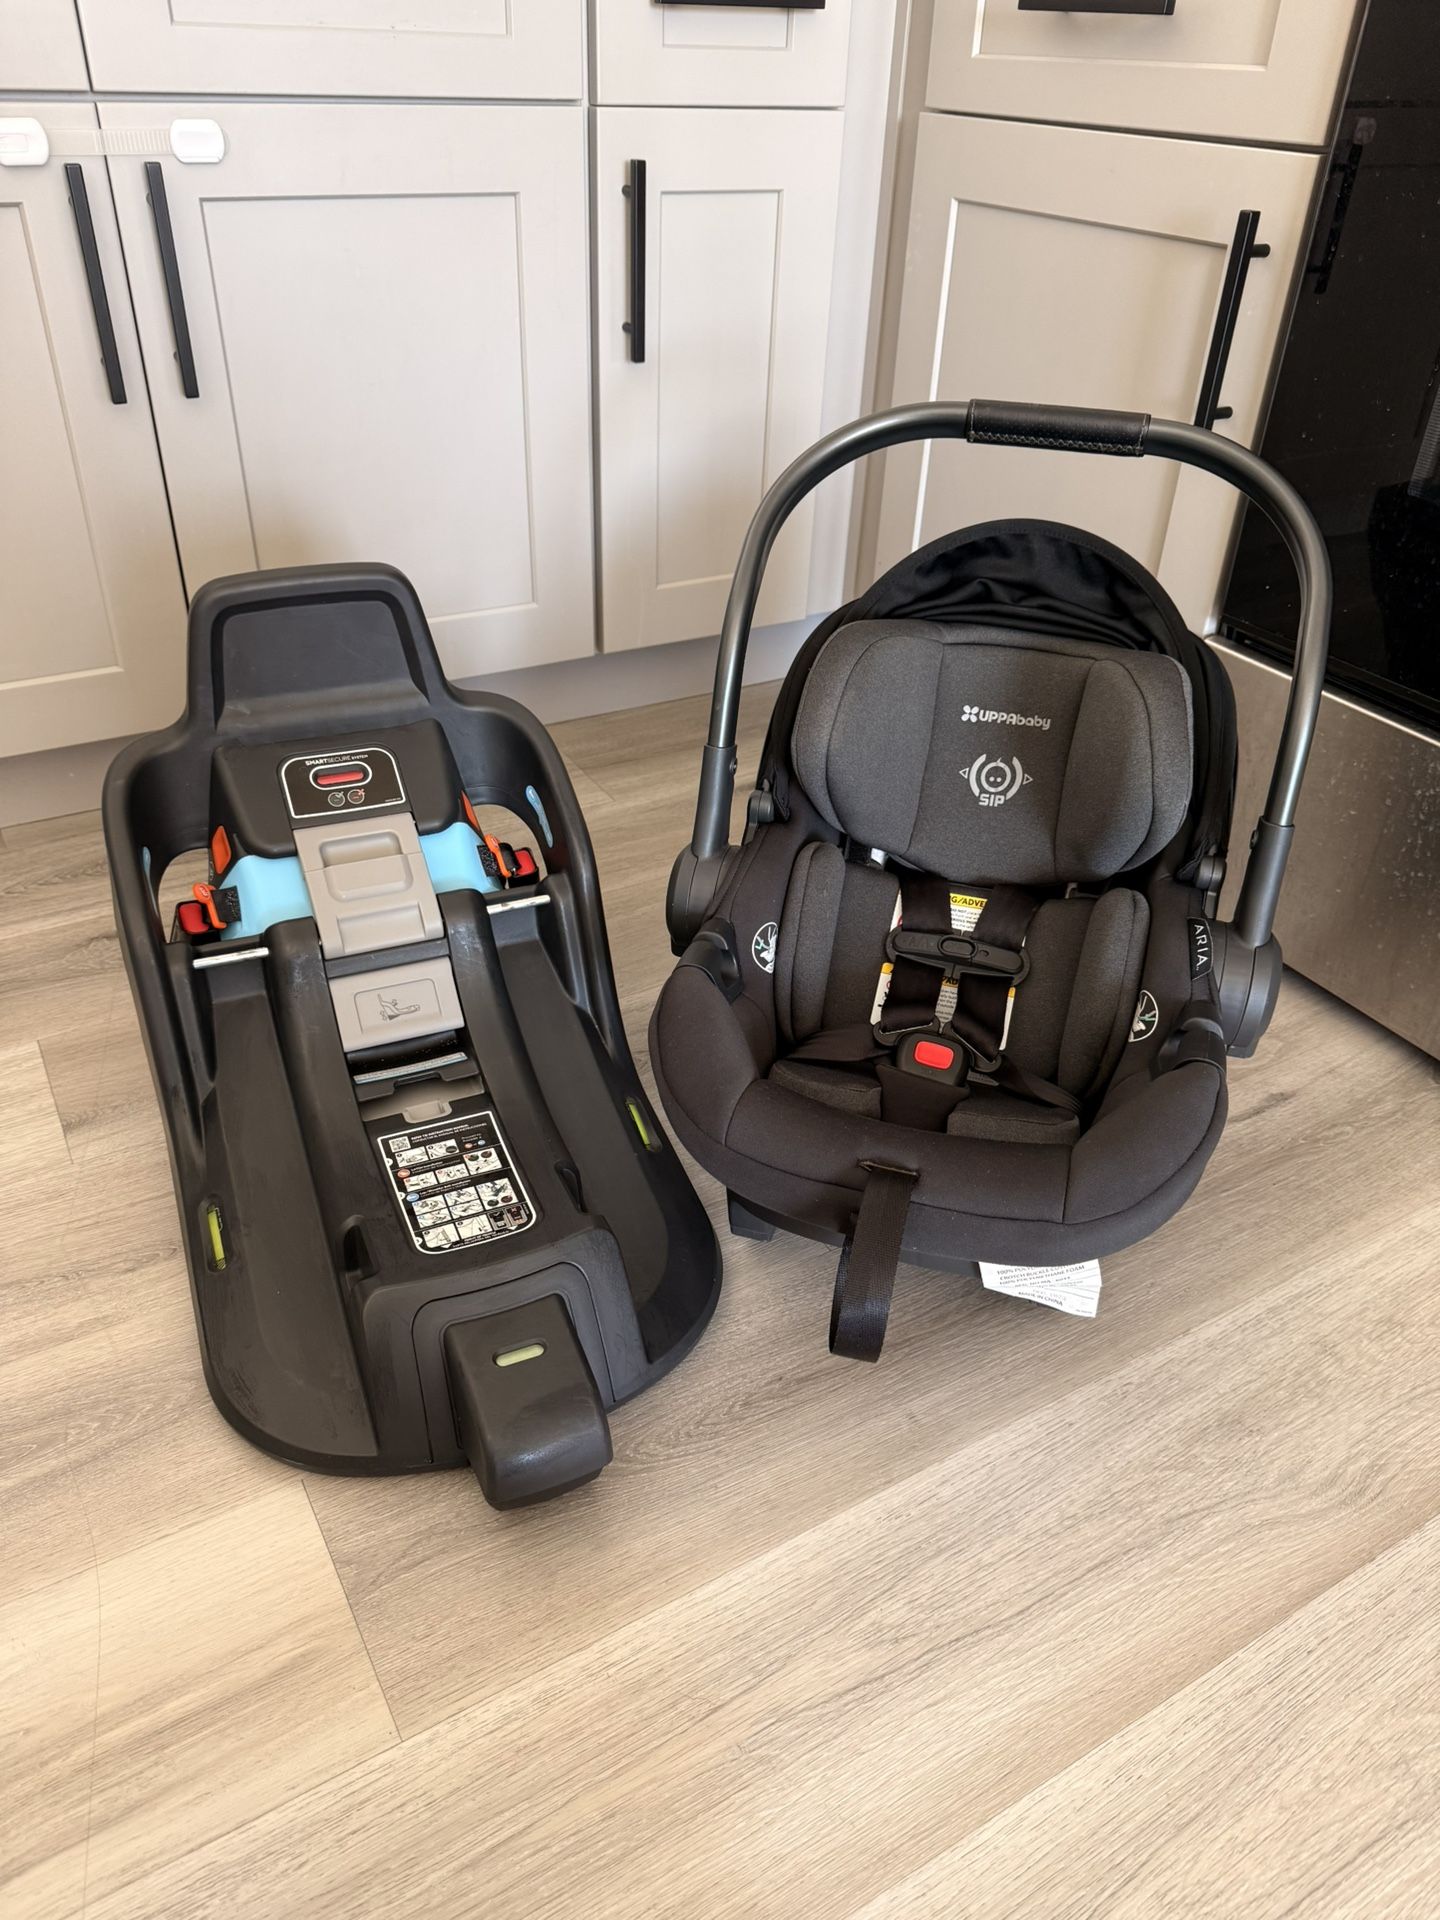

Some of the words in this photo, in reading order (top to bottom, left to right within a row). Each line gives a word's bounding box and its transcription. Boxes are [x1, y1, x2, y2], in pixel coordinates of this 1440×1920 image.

[979, 709, 1051, 730] UPPAbaby
[979, 793, 1005, 807] SIP
[1194, 924, 1208, 967] ARIA
[1065, 1264, 1085, 1274] FOAM
[1044, 1296, 1064, 1307] CHINA
